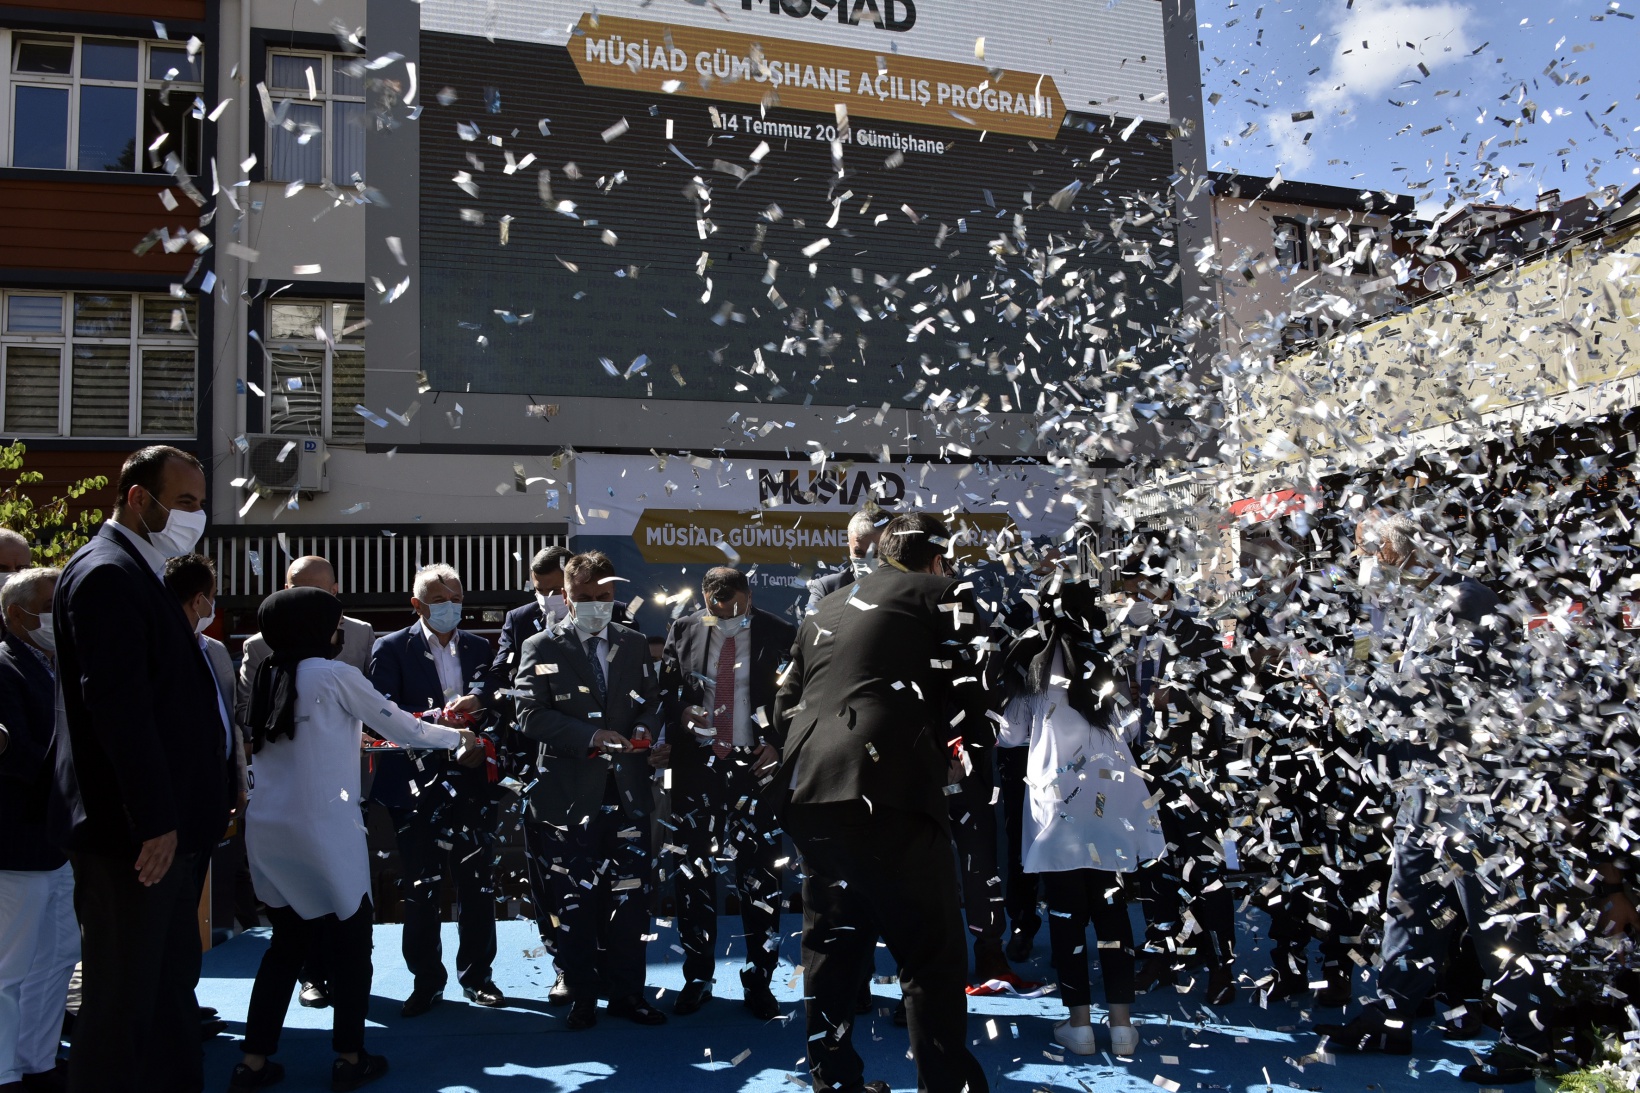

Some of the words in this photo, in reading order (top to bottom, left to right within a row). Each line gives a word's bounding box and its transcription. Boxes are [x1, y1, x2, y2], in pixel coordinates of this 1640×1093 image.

[585, 34, 688, 72] MÜSİAD
[857, 71, 931, 107] AÇILIŞ
[721, 113, 739, 131] 14
[743, 115, 812, 140] Temmuz
[815, 124, 852, 144] 201
[856, 129, 945, 154] Gümüşhane
[645, 523, 723, 547] MÜSİAD
[729, 525, 849, 550] GÜMÜŞHANE
